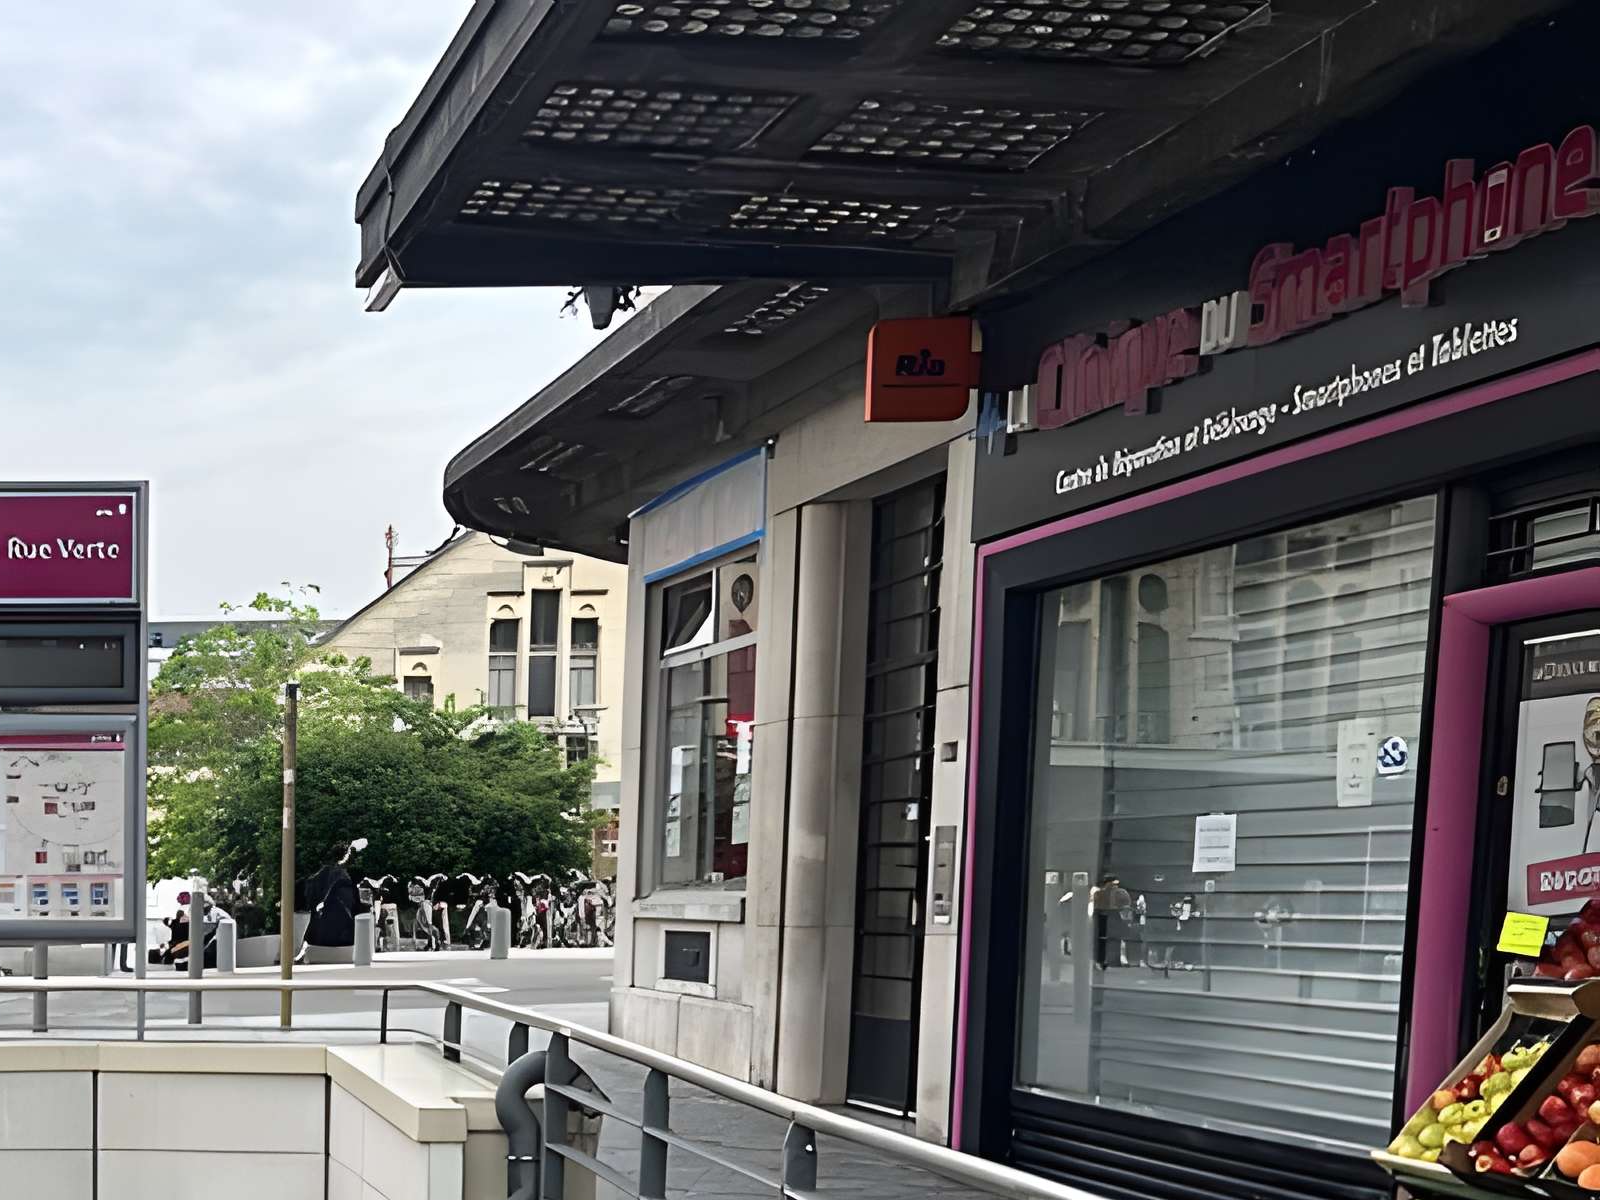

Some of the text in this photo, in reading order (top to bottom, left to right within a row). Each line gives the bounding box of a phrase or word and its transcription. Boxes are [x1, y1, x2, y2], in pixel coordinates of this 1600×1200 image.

[1248, 125, 1600, 346] Smartphone
[1431, 318, 1518, 367] Tablettes
[56, 538, 120, 560] Verte
